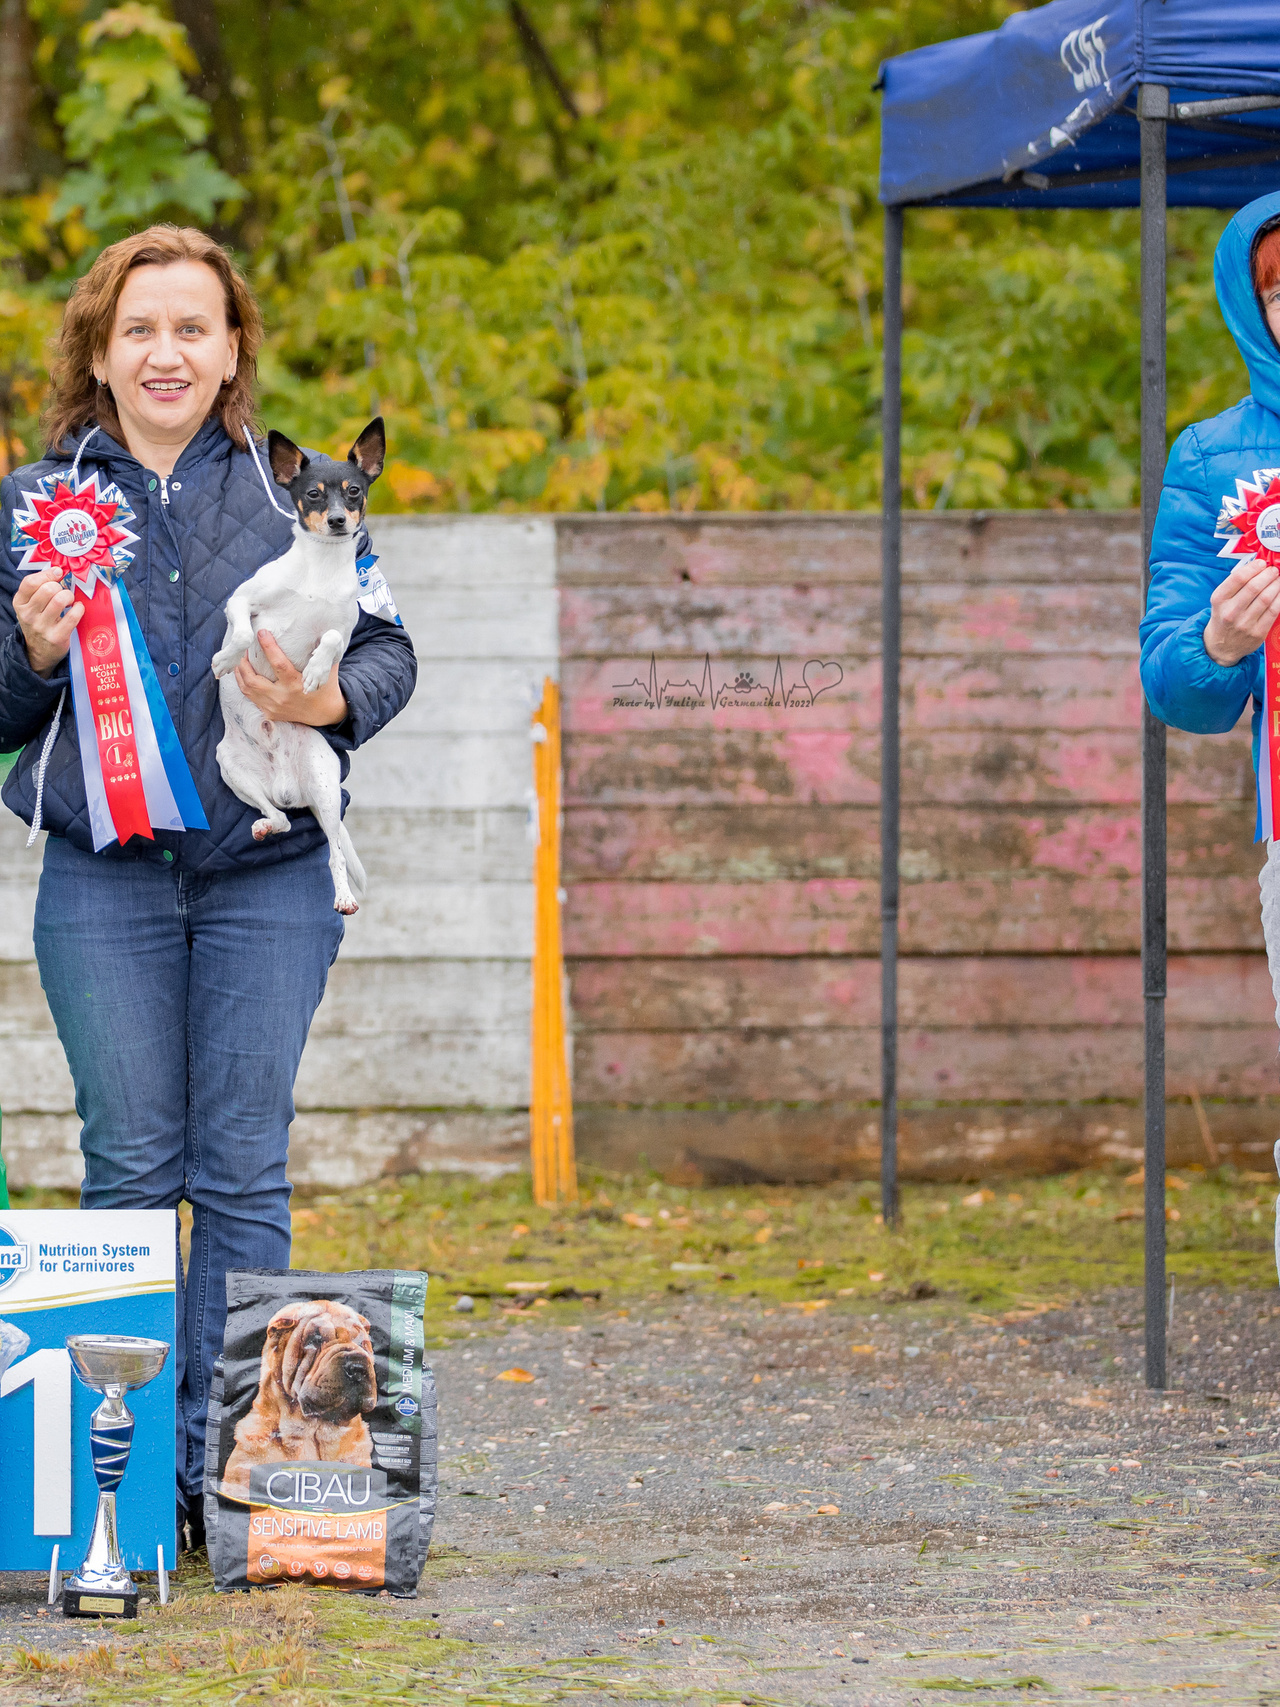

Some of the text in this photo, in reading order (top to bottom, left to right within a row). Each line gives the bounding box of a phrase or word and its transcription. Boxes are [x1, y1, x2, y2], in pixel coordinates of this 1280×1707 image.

[90, 662, 121, 673] ВЫСТАВКА
[96, 669, 117, 678] СОБАК
[97, 682, 120, 691] ПОРОД
[100, 676, 115, 684] ВСЕХ
[97, 709, 133, 740] BIG
[113, 746, 121, 764] 1
[39, 1243, 150, 1258] Nutrition System
[39, 1260, 135, 1272] for Carnivores
[404, 1310, 415, 1335] MAXI
[402, 1349, 415, 1392] MEDIUM
[0, 1348, 72, 1536] 1
[266, 1471, 371, 1505] CIBAU
[252, 1517, 383, 1540] SENSITIVE LAMB
